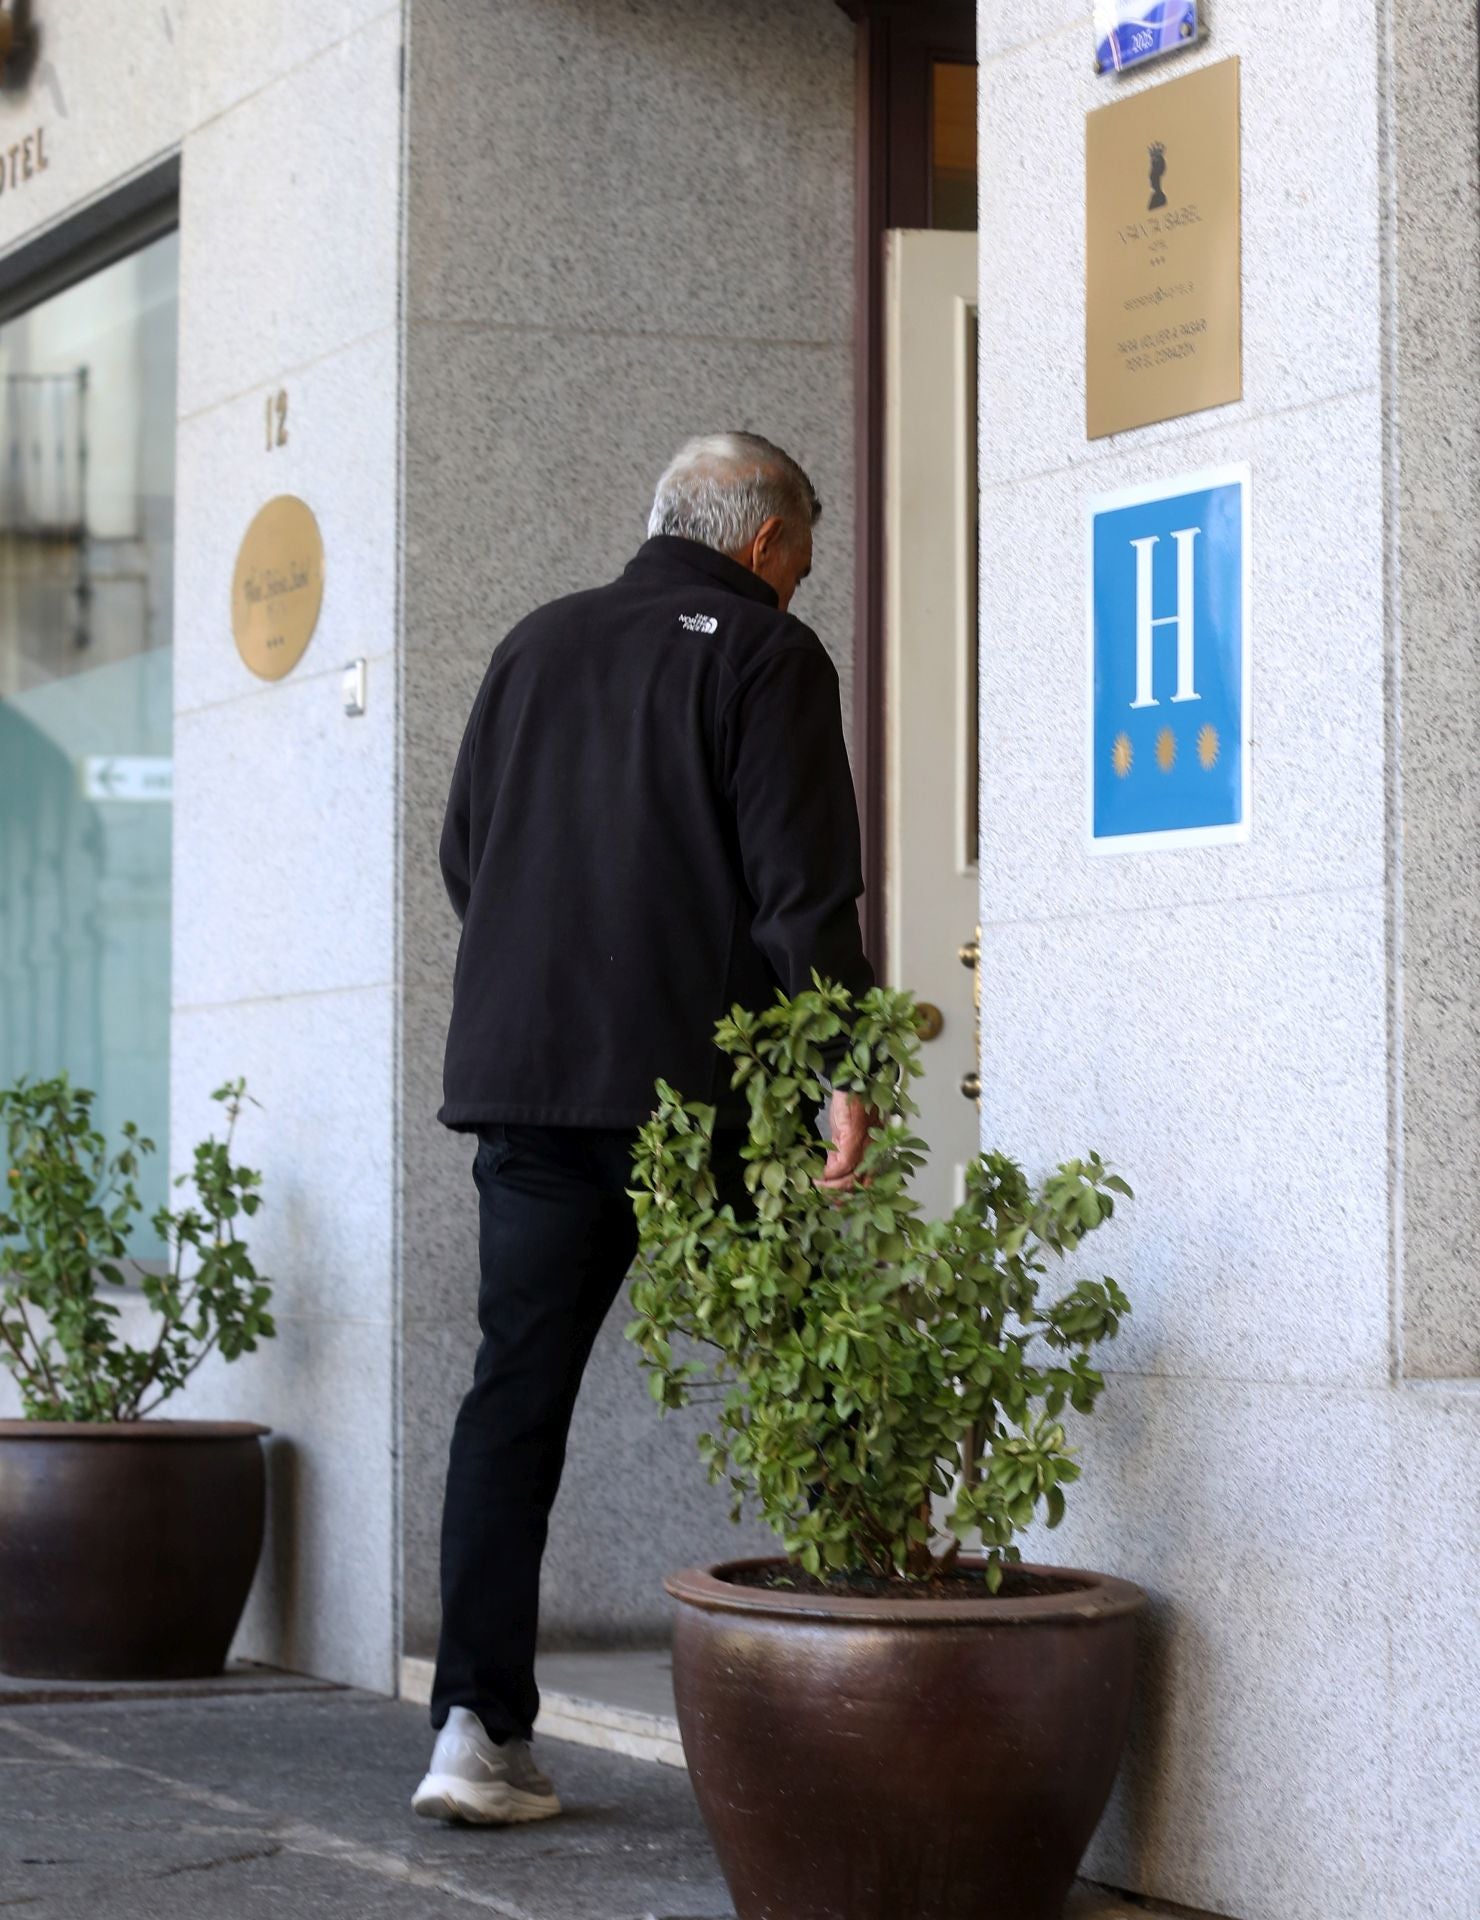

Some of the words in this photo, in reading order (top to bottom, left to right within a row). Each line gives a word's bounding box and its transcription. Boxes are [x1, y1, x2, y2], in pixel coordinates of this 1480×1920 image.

[265, 388, 288, 452] 12
[678, 613, 706, 628] NORTH
[1129, 526, 1202, 709] H
